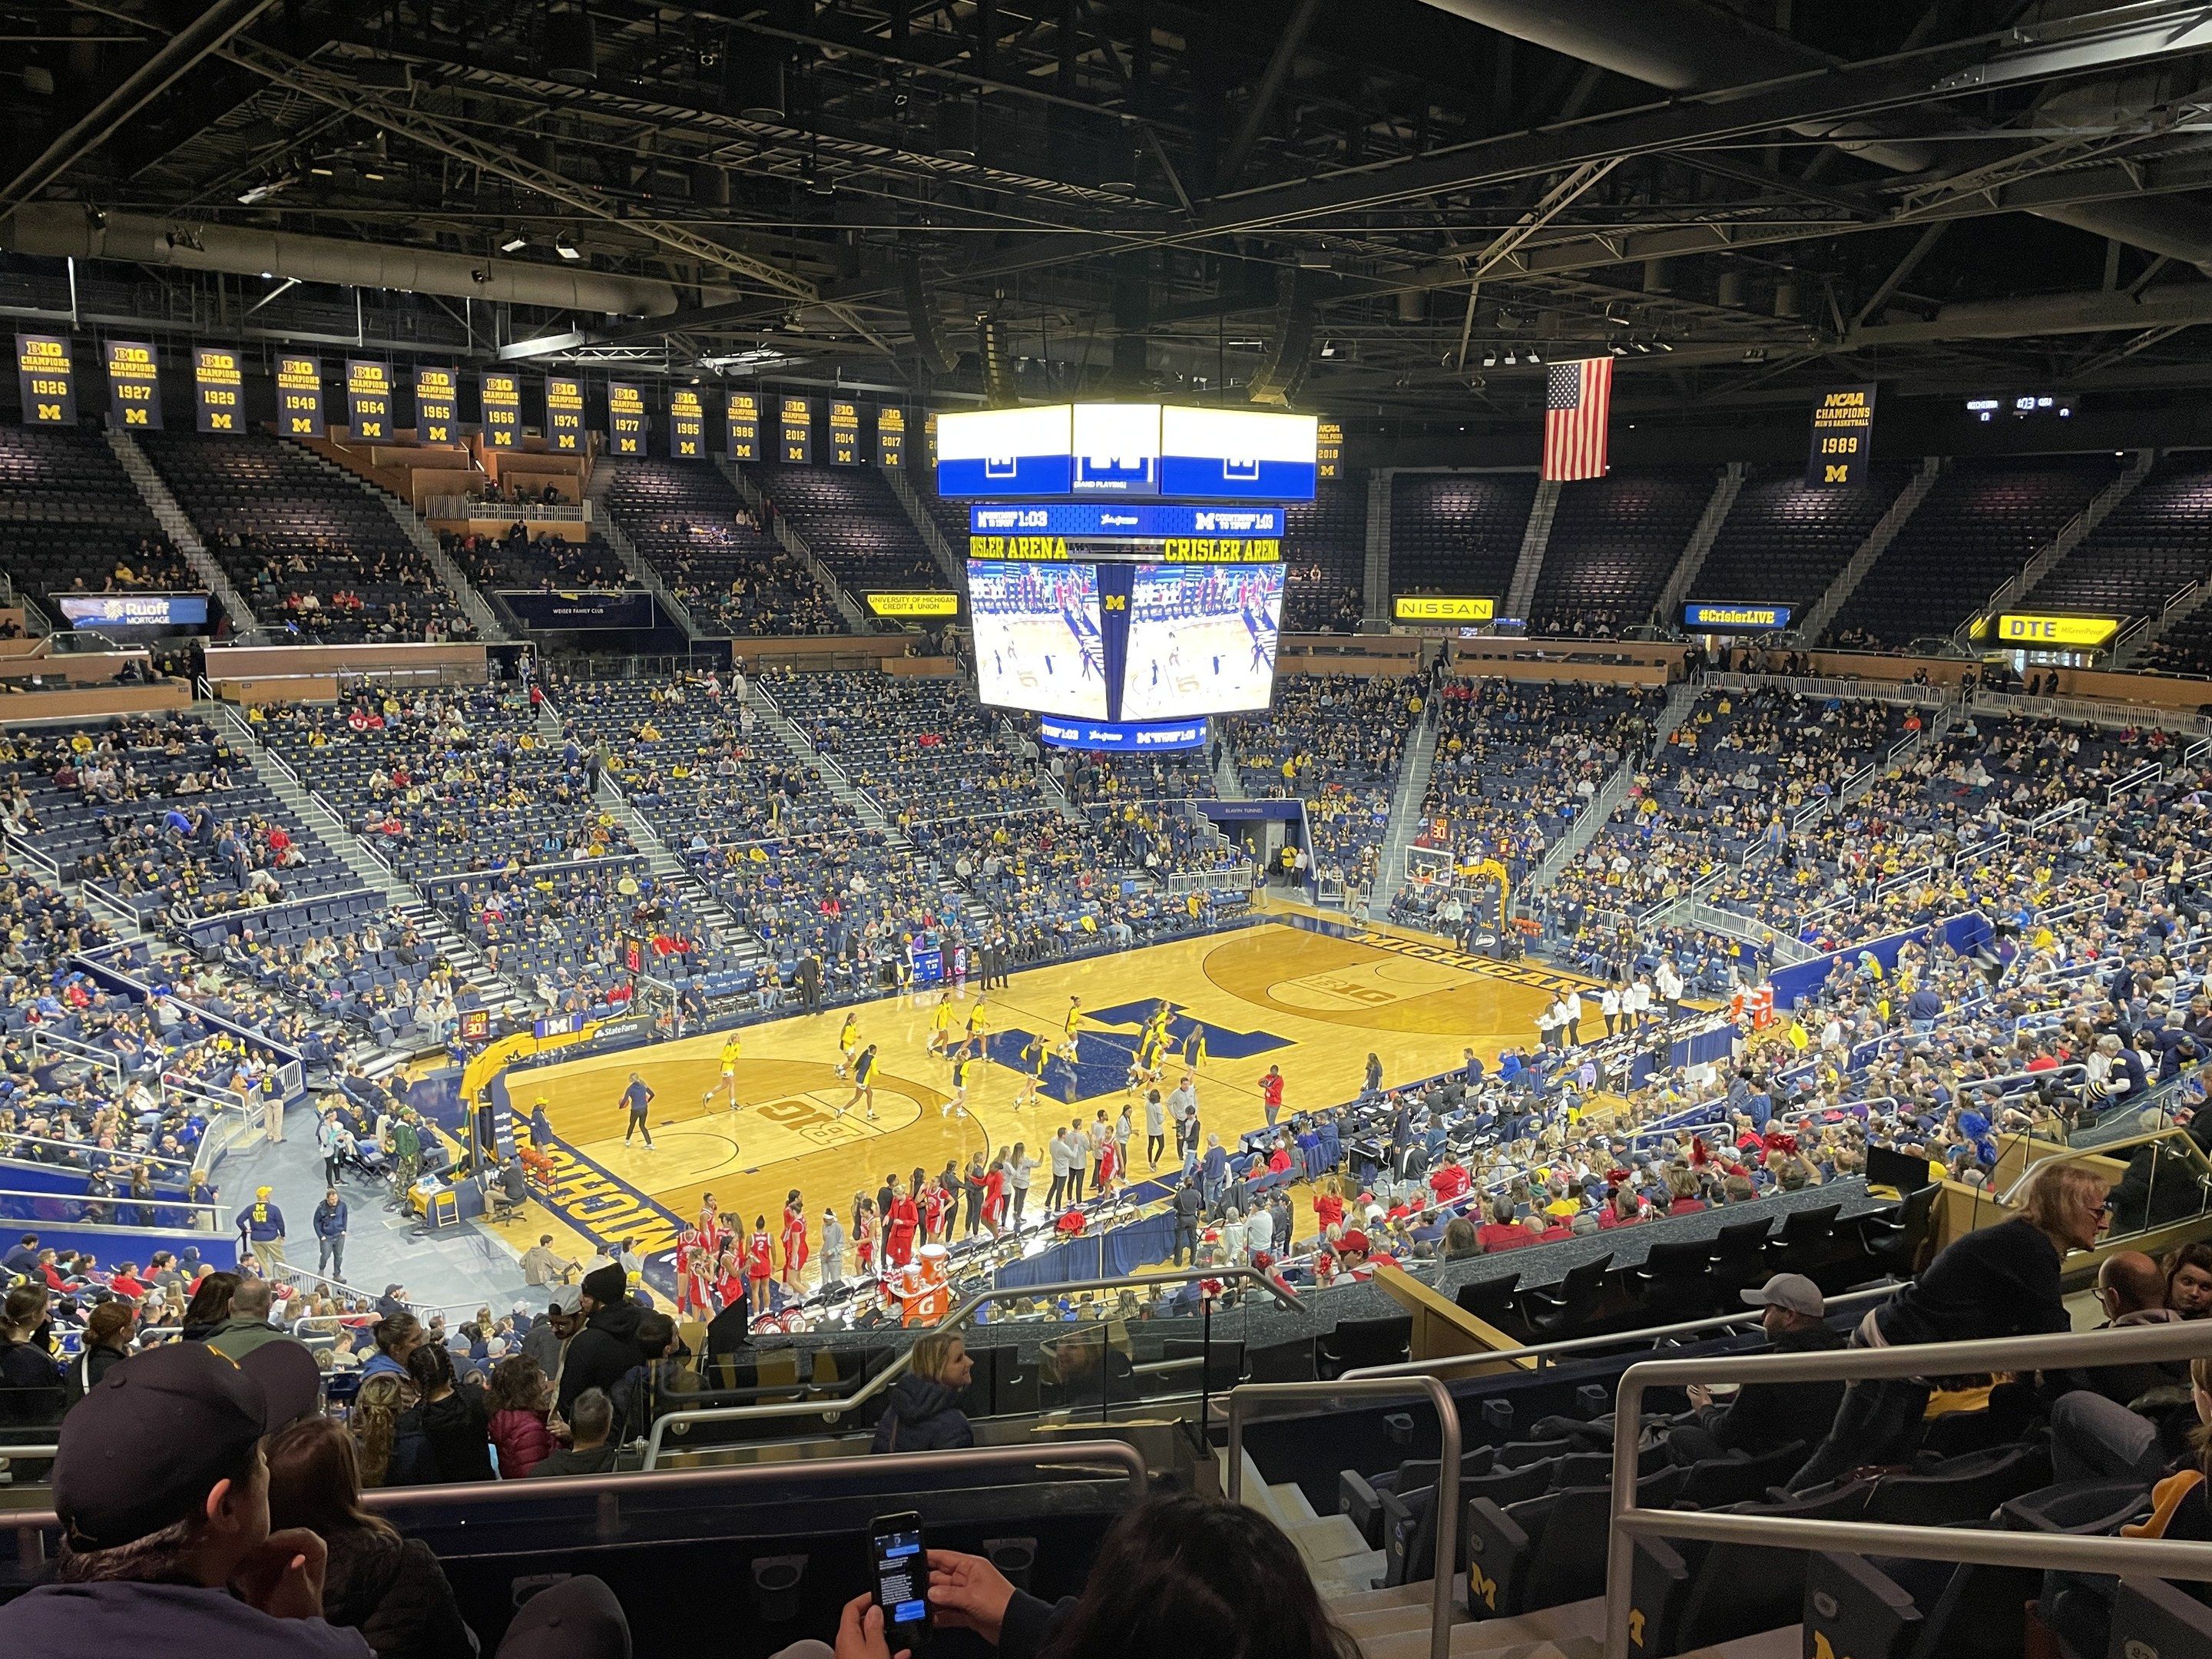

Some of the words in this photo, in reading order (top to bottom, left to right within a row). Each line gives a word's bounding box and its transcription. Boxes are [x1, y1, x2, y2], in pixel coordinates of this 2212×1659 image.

[21, 355, 70, 367] CHAMPIONS
[109, 361, 157, 373] CHAMPIONS
[196, 367, 241, 379] CHAMPIONS
[278, 373, 320, 385] CHAMPIONS
[33, 380, 67, 396] 1926
[349, 379, 389, 389] CHAMPIONS
[417, 384, 455, 395] CHAMPIONS
[118, 386, 151, 399] 1927
[204, 391, 235, 405] 1929
[484, 390, 518, 400] CHAMPIONS
[287, 396, 316, 409] 1948
[548, 394, 582, 404] CHAMPIONS
[1824, 392, 1864, 406] NCAA
[38, 404, 61, 419] M
[357, 400, 384, 414] 1964
[424, 406, 449, 419] 1965
[1816, 407, 1870, 419] CHAMPIONS
[126, 409, 147, 424] M
[211, 413, 232, 429] M
[489, 412, 515, 423] 1966
[555, 416, 578, 427] 1974
[292, 418, 311, 432] M
[363, 422, 380, 436] M
[616, 419, 638, 431] 1977
[677, 423, 699, 435] 1985
[1833, 419, 1869, 427] BASKETBALL
[429, 427, 446, 441] M
[733, 426, 753, 438] 1986
[786, 430, 805, 441] 2012
[495, 432, 511, 445] M
[559, 435, 575, 448] M
[835, 433, 854, 444] 2014
[882, 436, 901, 446] 2017
[621, 439, 636, 451] M
[680, 442, 695, 454] M
[737, 445, 750, 457] M
[1821, 437, 1857, 453] 1989
[790, 448, 802, 459] M
[838, 450, 851, 462] M
[886, 454, 898, 465] M
[1318, 449, 1338, 459] 2018
[1824, 465, 1848, 482] M
[1018, 511, 1048, 527] 1:03
[1008, 537, 1068, 559] ARENA
[1164, 539, 1240, 561] CRISLER
[1243, 540, 1280, 561] ARENA
[125, 602, 169, 615] Ruoff
[1106, 595, 1125, 610] M
[1402, 603, 1487, 614] NISSAN
[126, 616, 170, 624] MORTGAGE
[1699, 609, 1775, 624] #CrislerLIVE
[2011, 620, 2057, 637] DTE
[1346, 932, 1602, 997] MICHIGAN
[470, 1013, 487, 1022] 1:03
[468, 1023, 482, 1035] 30
[512, 1116, 678, 1257] MICHIG
[757, 1241, 764, 1251] 2
[919, 1295, 934, 1315] G
